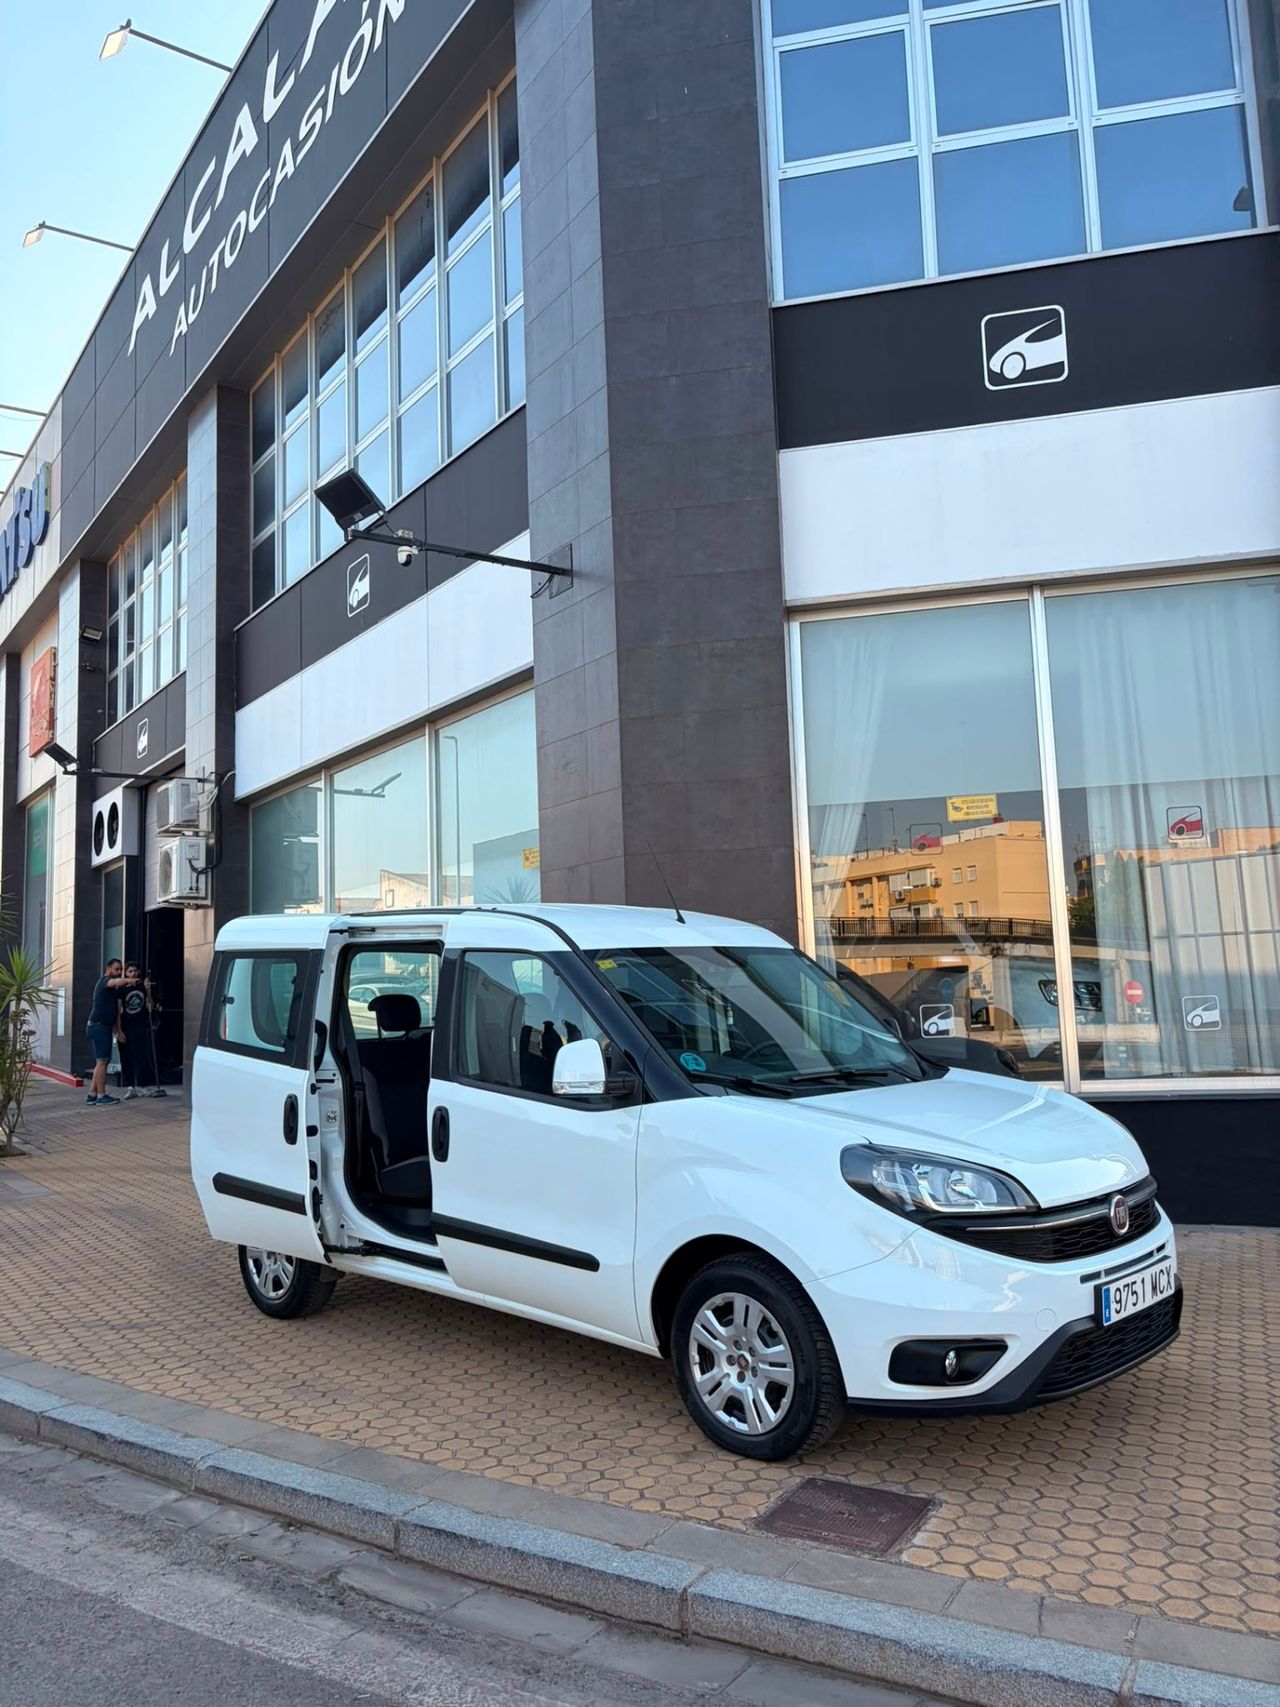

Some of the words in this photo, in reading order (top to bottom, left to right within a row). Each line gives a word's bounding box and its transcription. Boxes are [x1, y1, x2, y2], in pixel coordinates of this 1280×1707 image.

[170, 0, 406, 357] AUTOCASIÓN
[1114, 1277, 1146, 1314] 9751
[1150, 1264, 1173, 1299] MCX
